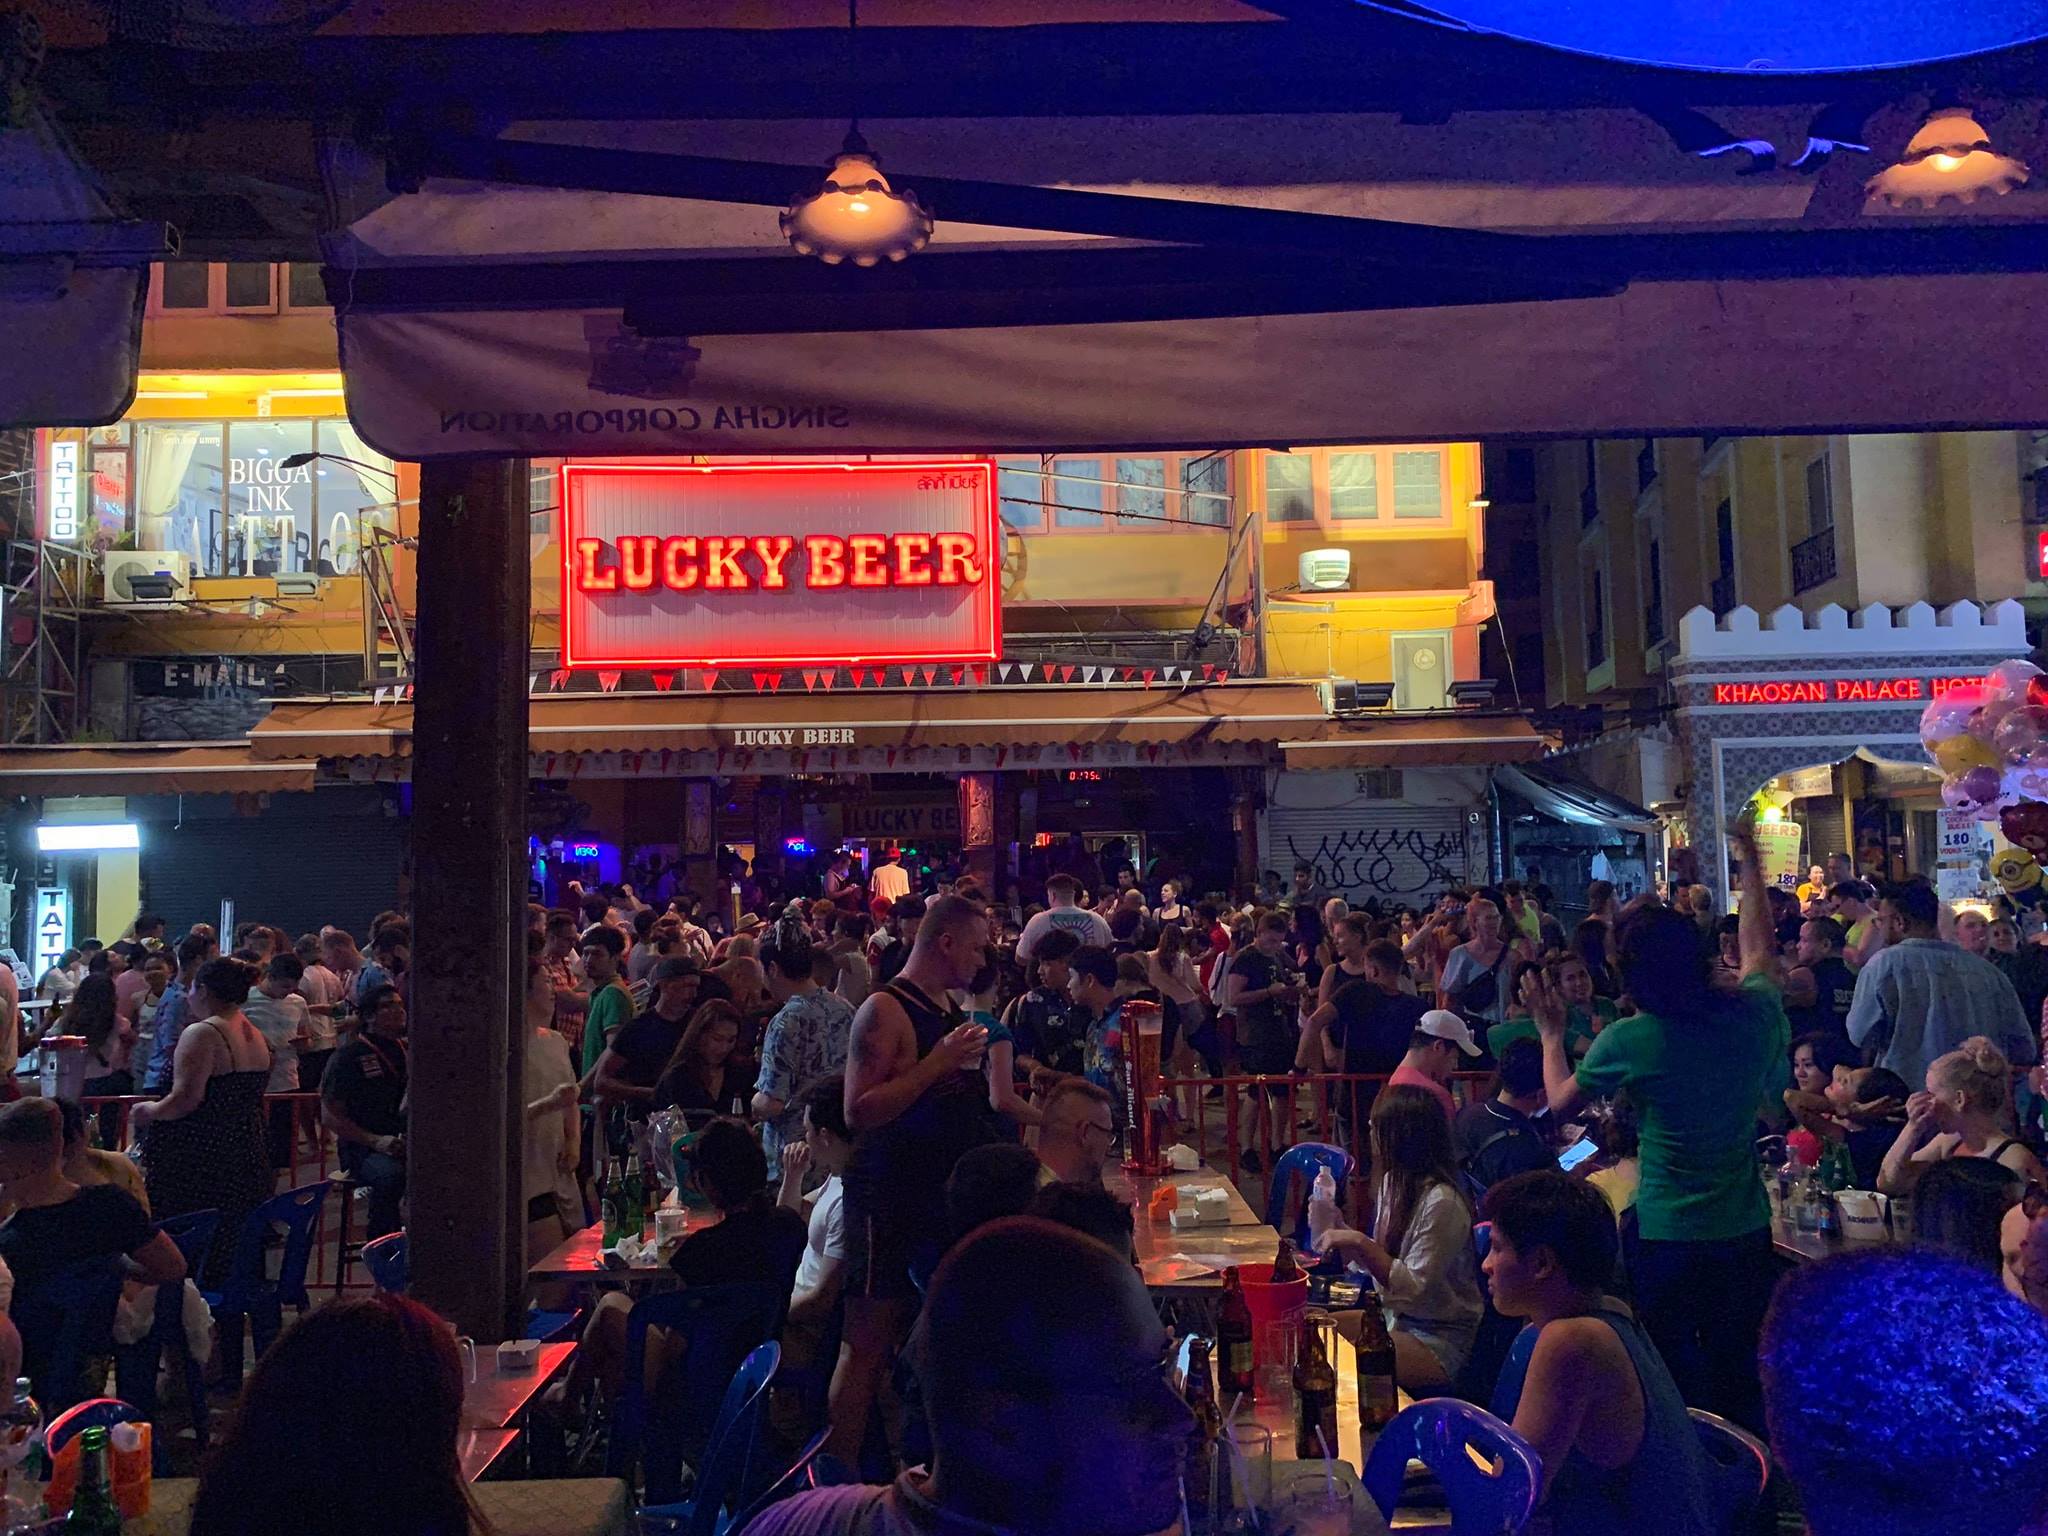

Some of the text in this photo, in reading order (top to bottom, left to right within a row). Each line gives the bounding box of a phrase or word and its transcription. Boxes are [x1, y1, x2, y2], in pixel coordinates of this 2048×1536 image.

[229, 457, 312, 484] BIGGA
[55, 446, 73, 535] TATTOO
[247, 485, 294, 512] INK
[576, 532, 984, 593] LUCKY BEER
[164, 663, 265, 687] E-MAIL
[1716, 682, 1826, 703] KHAOSAN
[1836, 678, 1922, 700] PALACE
[734, 728, 855, 746] LUCKY BEER
[853, 807, 957, 832] LUCKY BE
[1944, 832, 1970, 846] 180
[1777, 873, 1797, 886] 180
